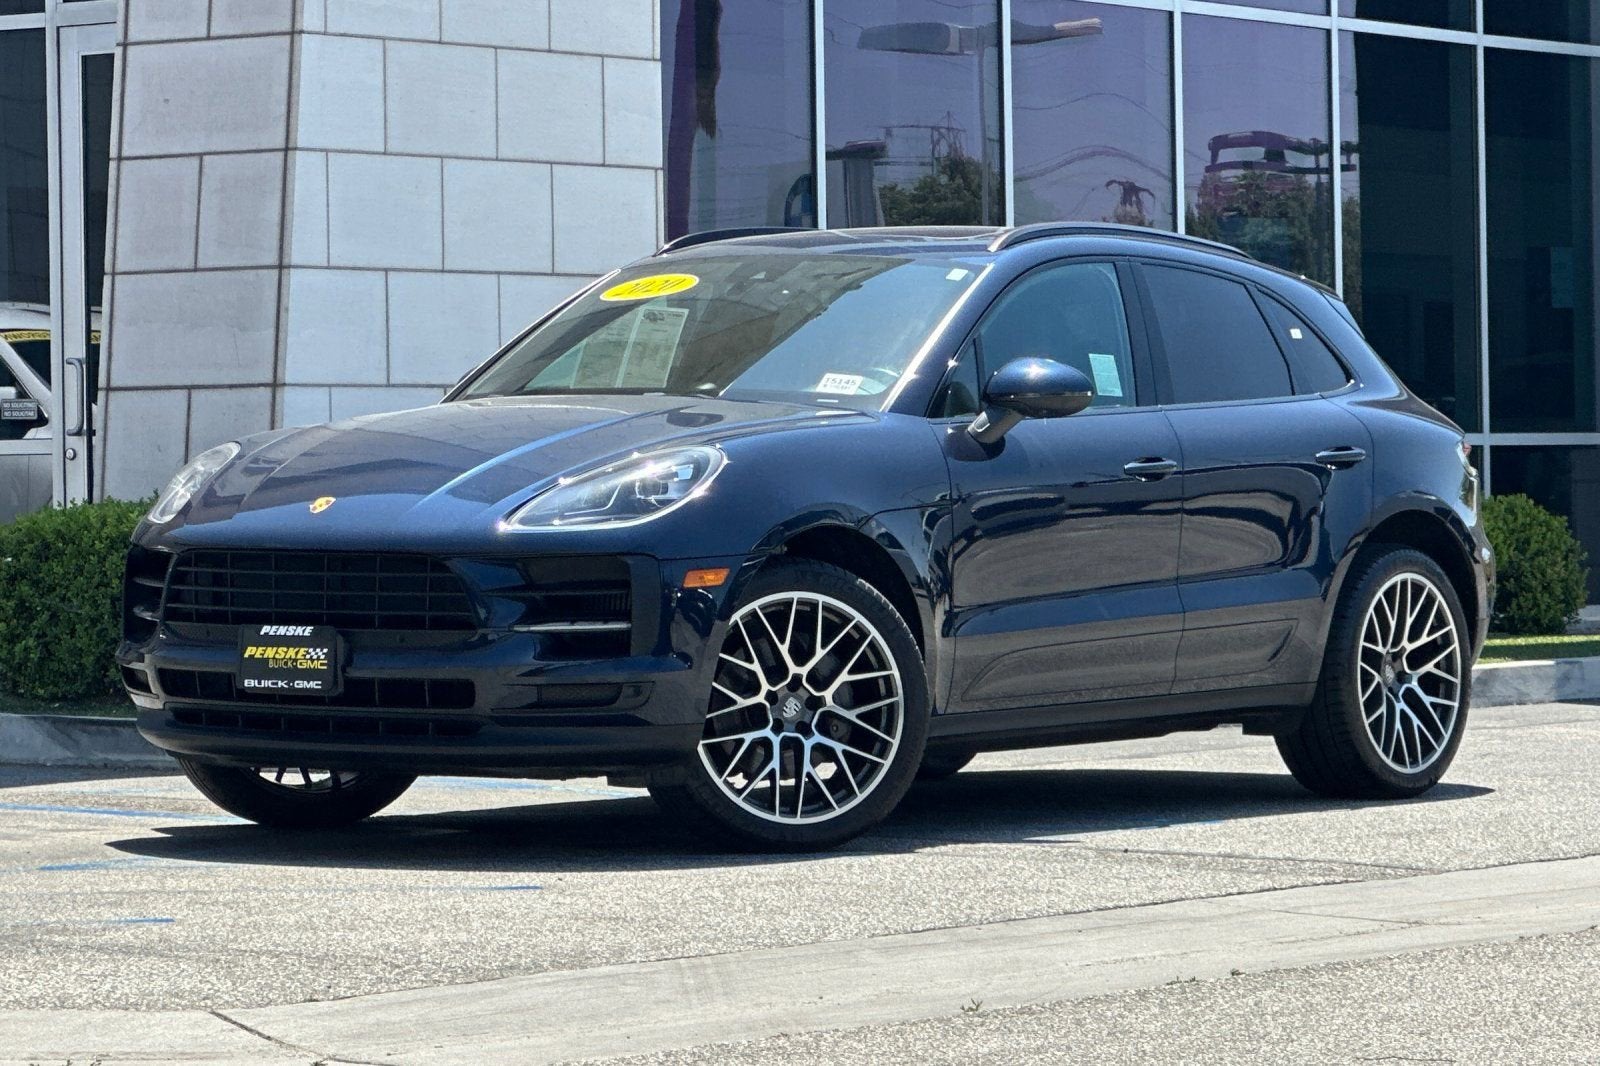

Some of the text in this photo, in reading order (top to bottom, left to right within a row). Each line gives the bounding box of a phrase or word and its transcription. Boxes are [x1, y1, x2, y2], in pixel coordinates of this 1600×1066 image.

[612, 278, 687, 296] 2020
[260, 625, 314, 636] PENSKE
[244, 647, 308, 659] PENSKE
